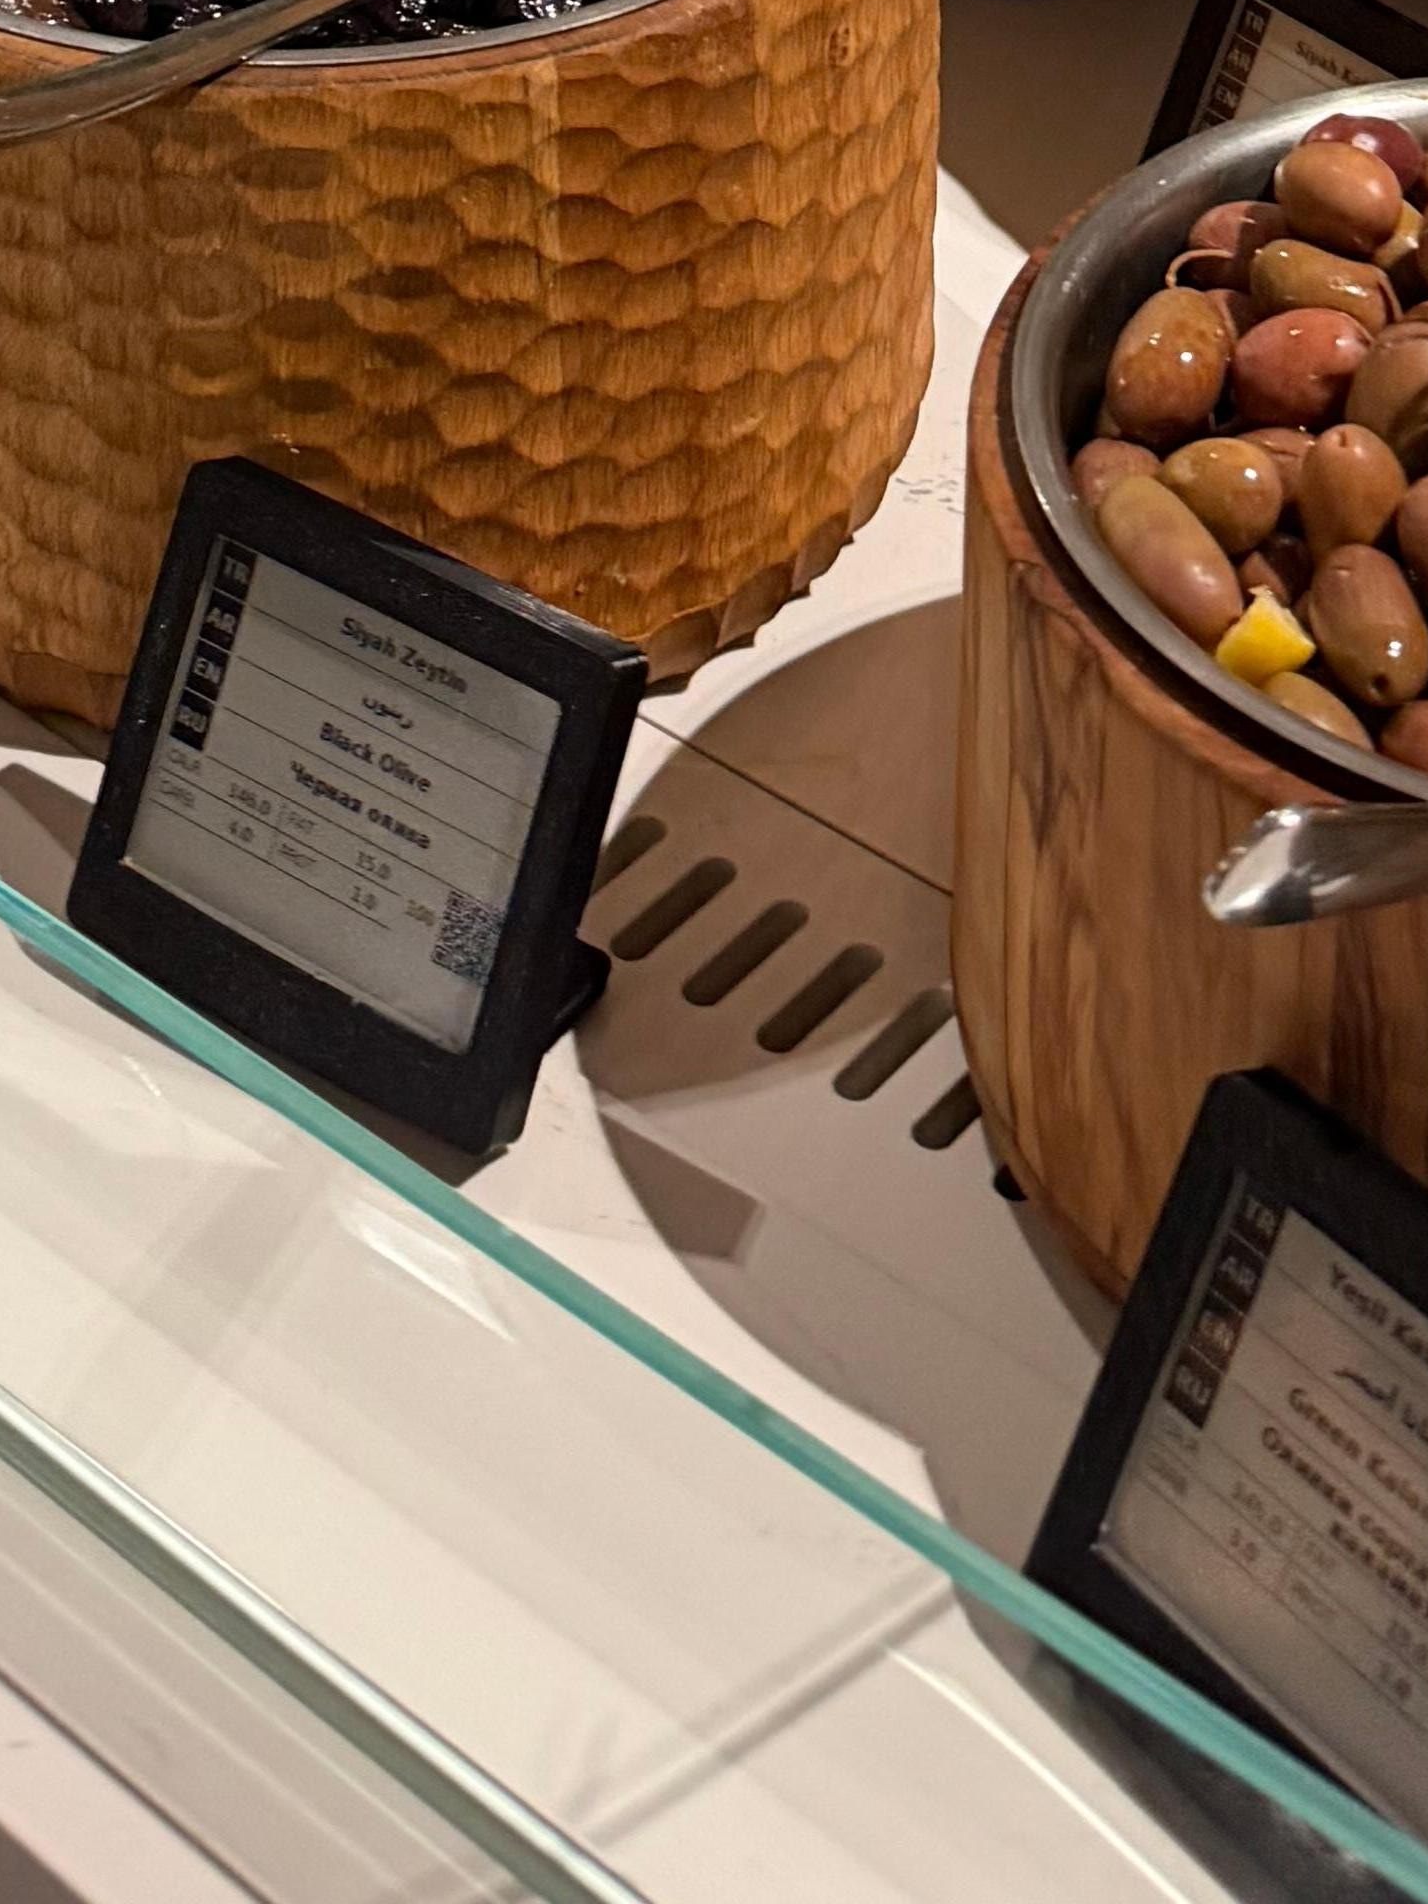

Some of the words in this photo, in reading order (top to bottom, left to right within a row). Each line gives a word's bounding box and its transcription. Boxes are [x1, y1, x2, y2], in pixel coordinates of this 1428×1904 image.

[206, 604, 237, 635] AR
[221, 555, 252, 586] TR
[338, 614, 399, 663] Siyah
[398, 644, 470, 699] Zeytin
[177, 704, 208, 735] RU
[193, 655, 222, 684] EN
[318, 720, 377, 766] Black
[376, 749, 434, 795] Olive
